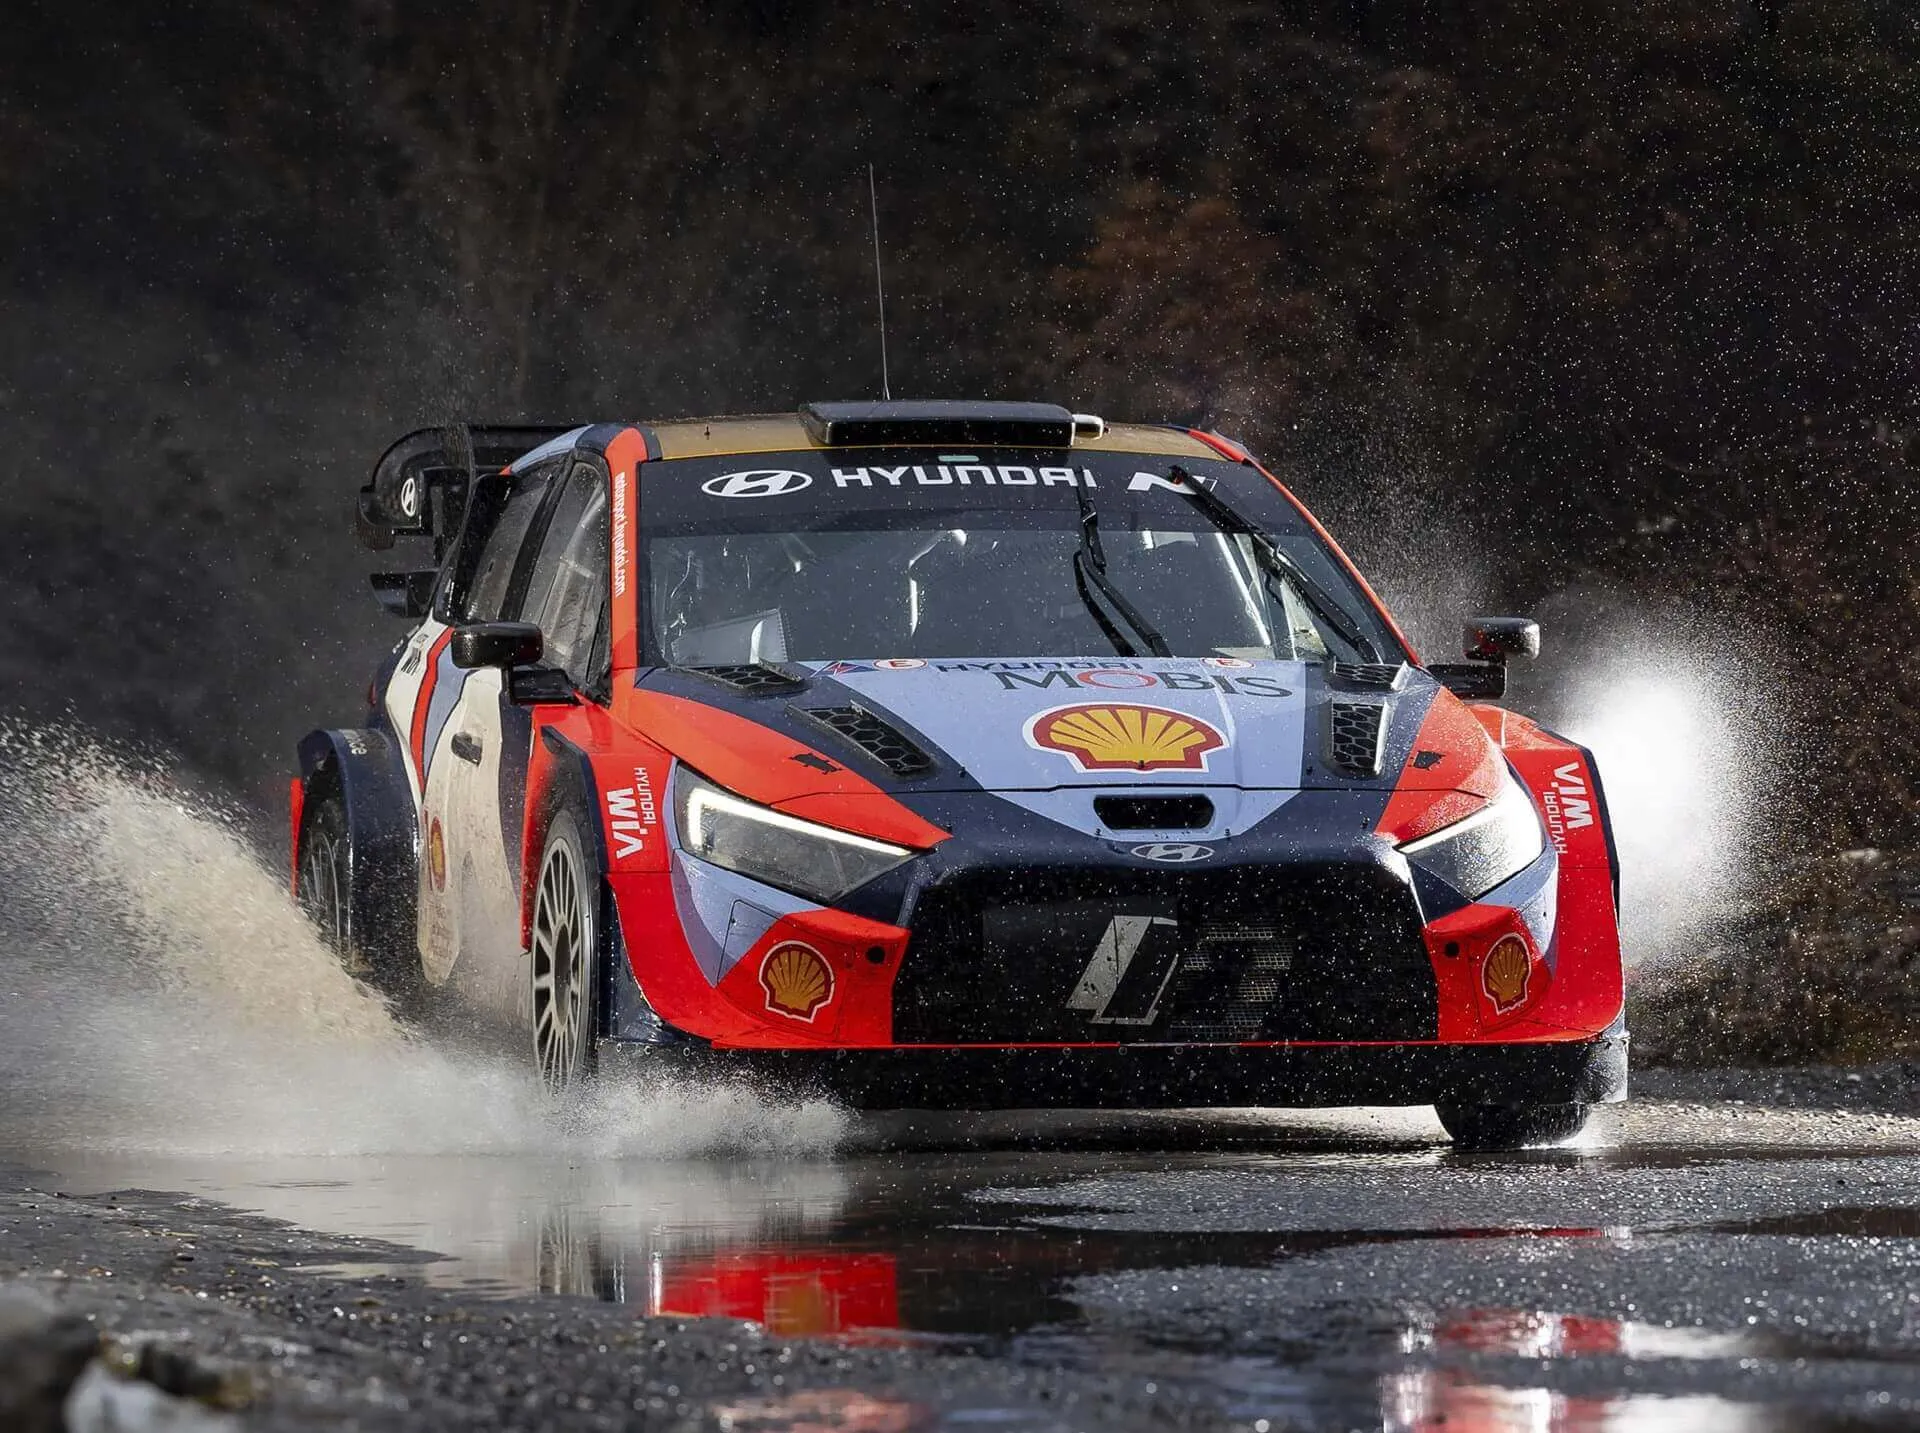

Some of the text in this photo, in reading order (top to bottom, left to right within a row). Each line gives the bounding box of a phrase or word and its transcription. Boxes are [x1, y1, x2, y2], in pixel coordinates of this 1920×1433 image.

[831, 465, 1217, 496] HYUNDAI N
[612, 472, 629, 598] motorsport.hyundai.com
[936, 662, 1143, 672] HYUNDAI
[992, 669, 1293, 698] MOBIS
[606, 787, 648, 860] WIA
[633, 767, 657, 825] HYUNDAI
[1543, 791, 1569, 855] HYUNDAI
[1551, 761, 1594, 830] WIA
